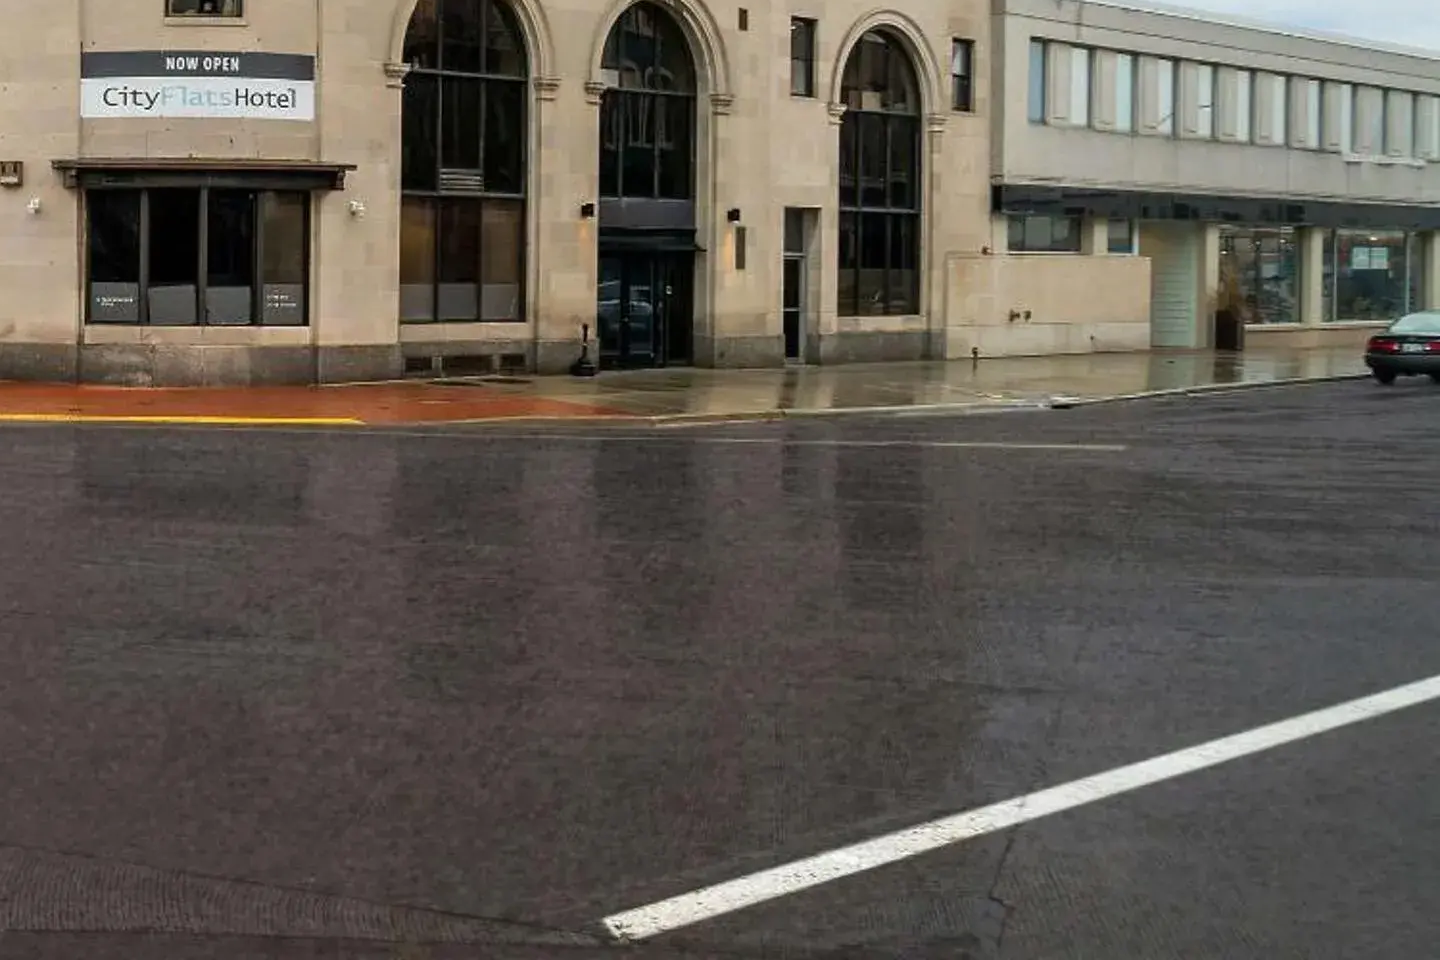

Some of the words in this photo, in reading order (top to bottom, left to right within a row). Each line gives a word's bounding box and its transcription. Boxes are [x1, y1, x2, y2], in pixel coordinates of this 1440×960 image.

[166, 56, 199, 71] NOW
[202, 56, 240, 72] OPEN
[102, 86, 297, 110] CityFlatsHotel
